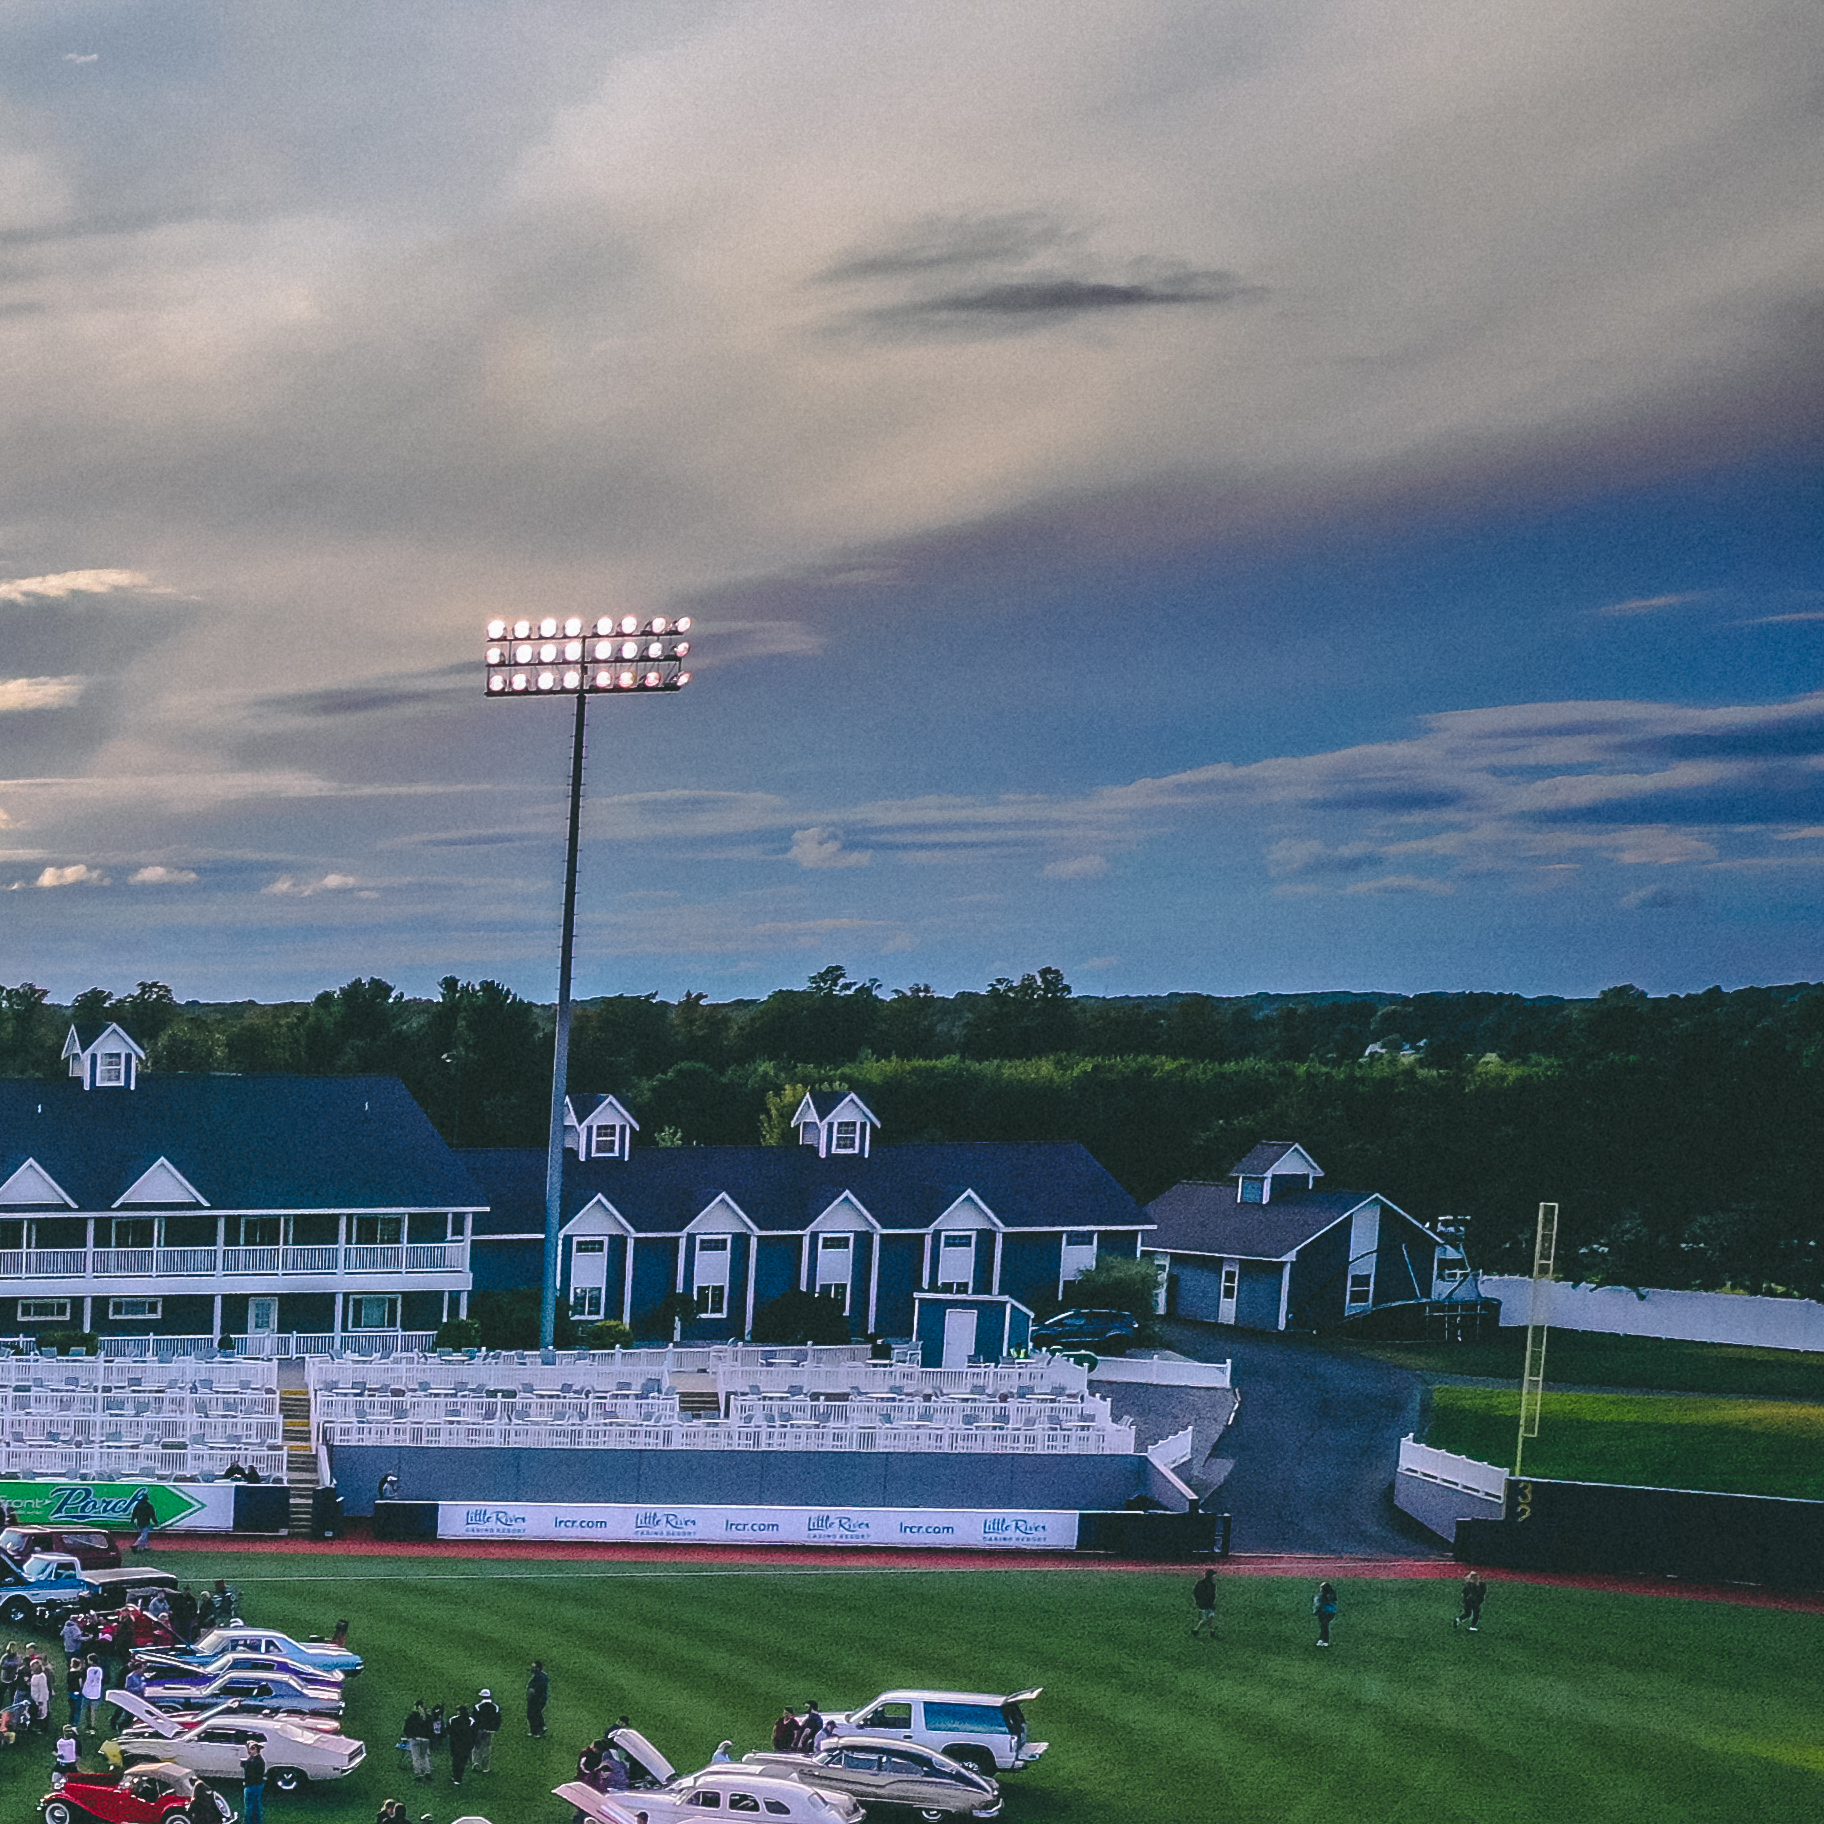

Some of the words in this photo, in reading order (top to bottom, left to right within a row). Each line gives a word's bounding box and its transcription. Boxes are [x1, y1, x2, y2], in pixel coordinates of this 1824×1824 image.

[466, 1509, 492, 1525] Little
[490, 1510, 526, 1526] River
[554, 1516, 607, 1528] lrcr.com
[635, 1512, 661, 1529] Little
[662, 1513, 697, 1529] River
[725, 1519, 779, 1532] lrcr.com
[807, 1515, 834, 1531] Little
[834, 1516, 870, 1532] River
[899, 1521, 954, 1534] lrcr.com
[983, 1518, 1010, 1534] Little
[1011, 1519, 1046, 1535] River
